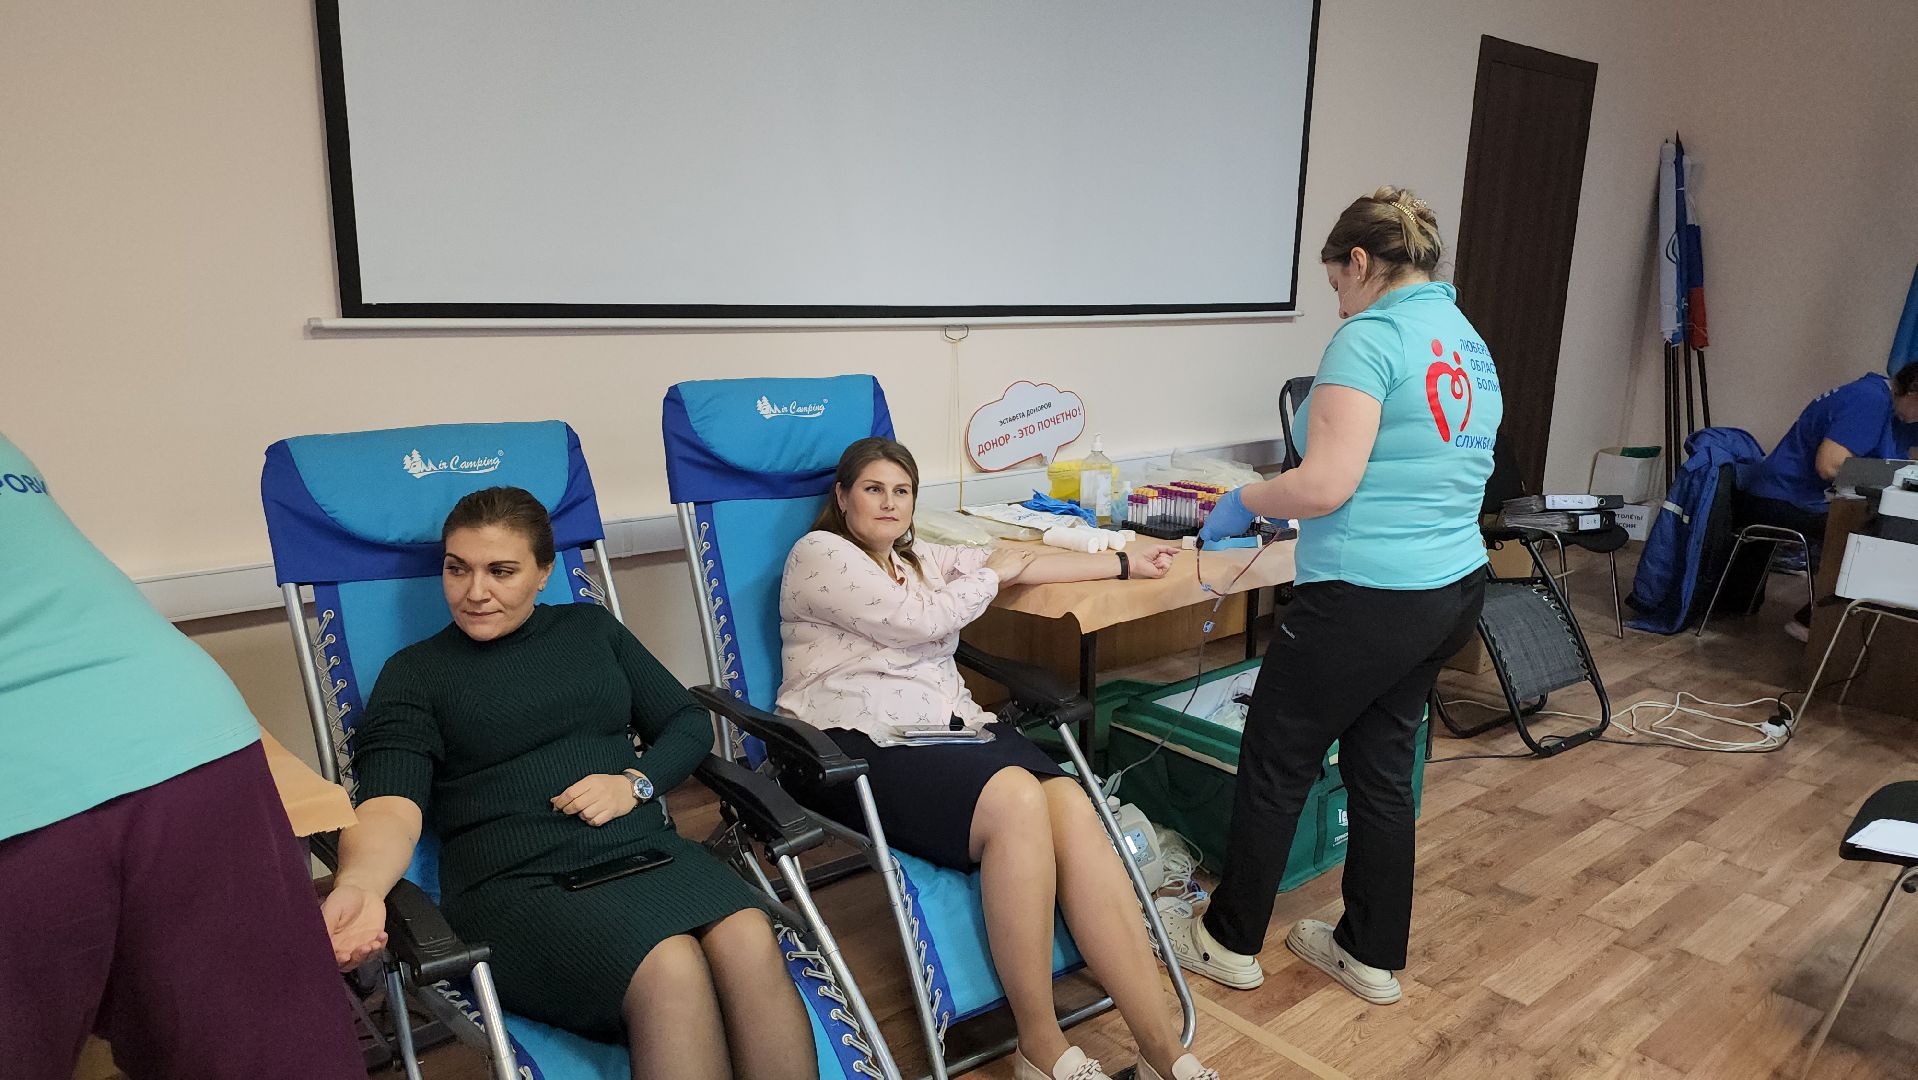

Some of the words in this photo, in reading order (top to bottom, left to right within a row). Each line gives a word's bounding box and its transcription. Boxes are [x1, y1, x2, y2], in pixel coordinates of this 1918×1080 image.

[789, 400, 825, 415] Camping
[999, 411, 1026, 427] ЭСТАФЕТА
[1026, 401, 1052, 418] ДОНОРОВ
[977, 433, 1011, 457] ДОНОР
[1018, 424, 1036, 439] ЭТО
[1037, 406, 1082, 432] ПОЧЕТНО!
[449, 455, 501, 471] Camping
[0, 473, 49, 496] ОВИ
